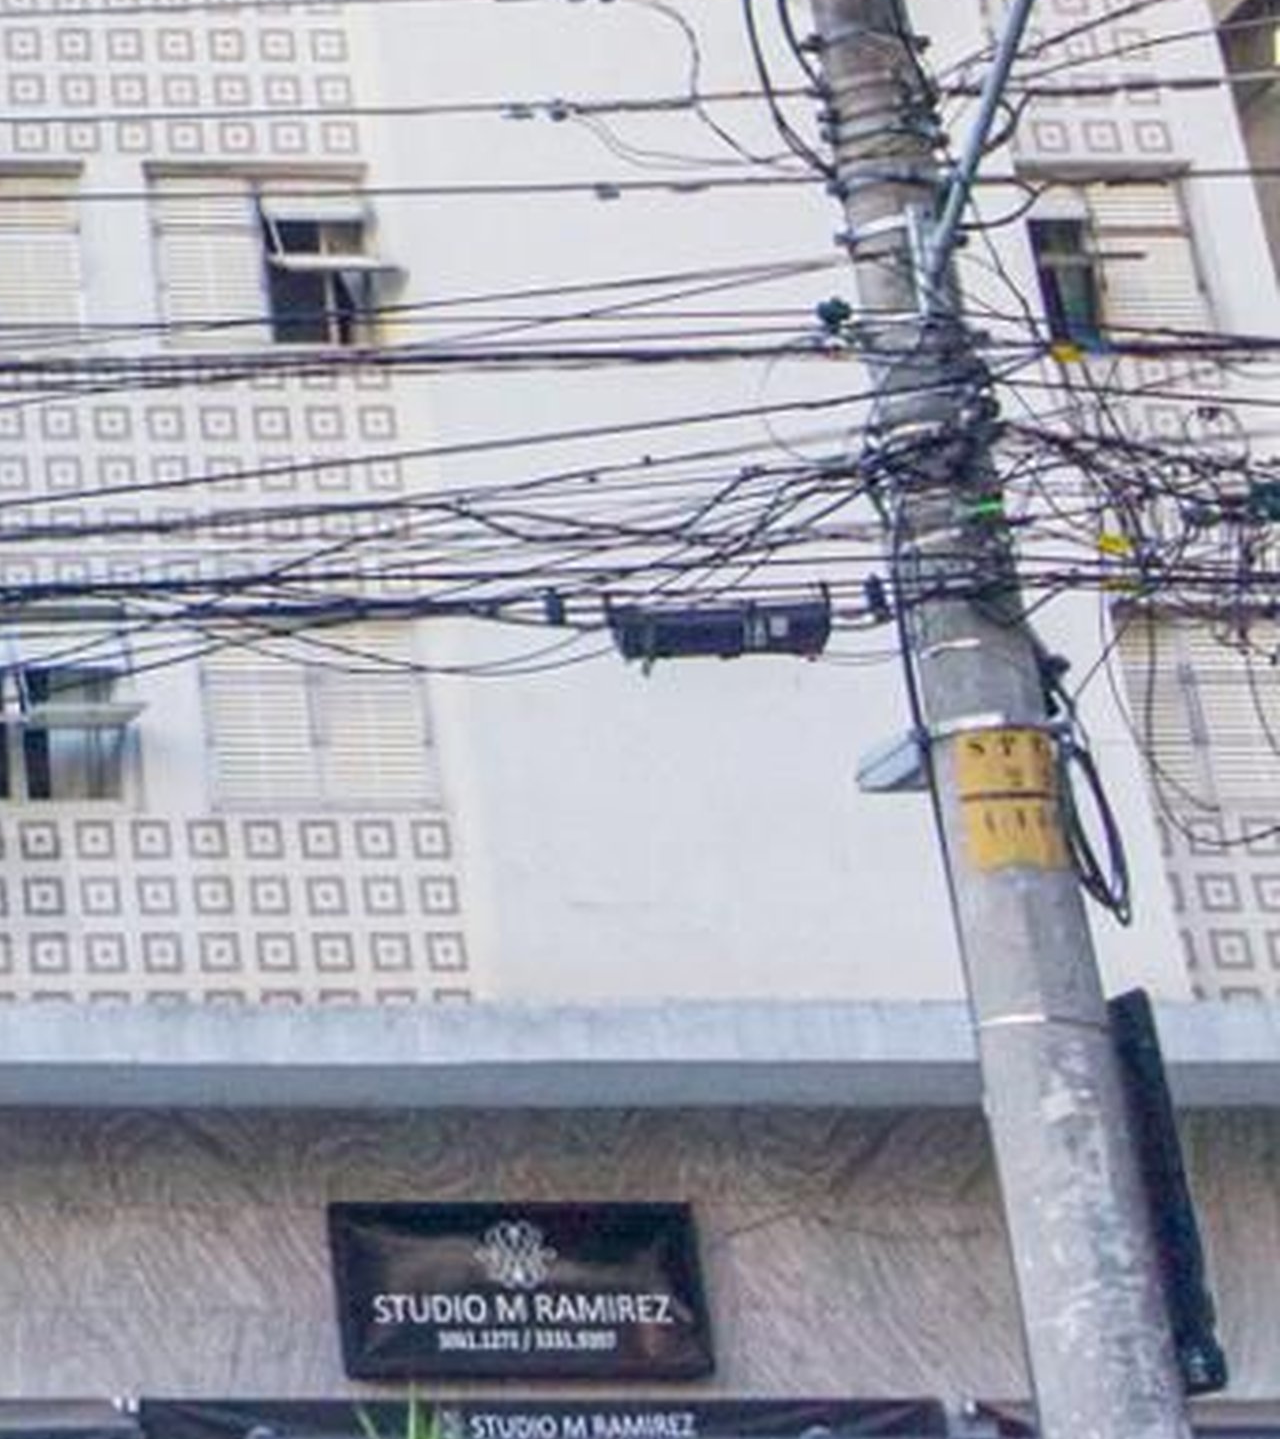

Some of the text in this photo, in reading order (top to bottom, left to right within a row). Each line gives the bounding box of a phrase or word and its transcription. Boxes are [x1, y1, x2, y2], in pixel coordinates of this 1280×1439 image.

[373, 1294, 674, 1323] STUDIO M RAMIREZ
[562, 1416, 588, 1439] M
[593, 1413, 696, 1438] RAMIREZ
